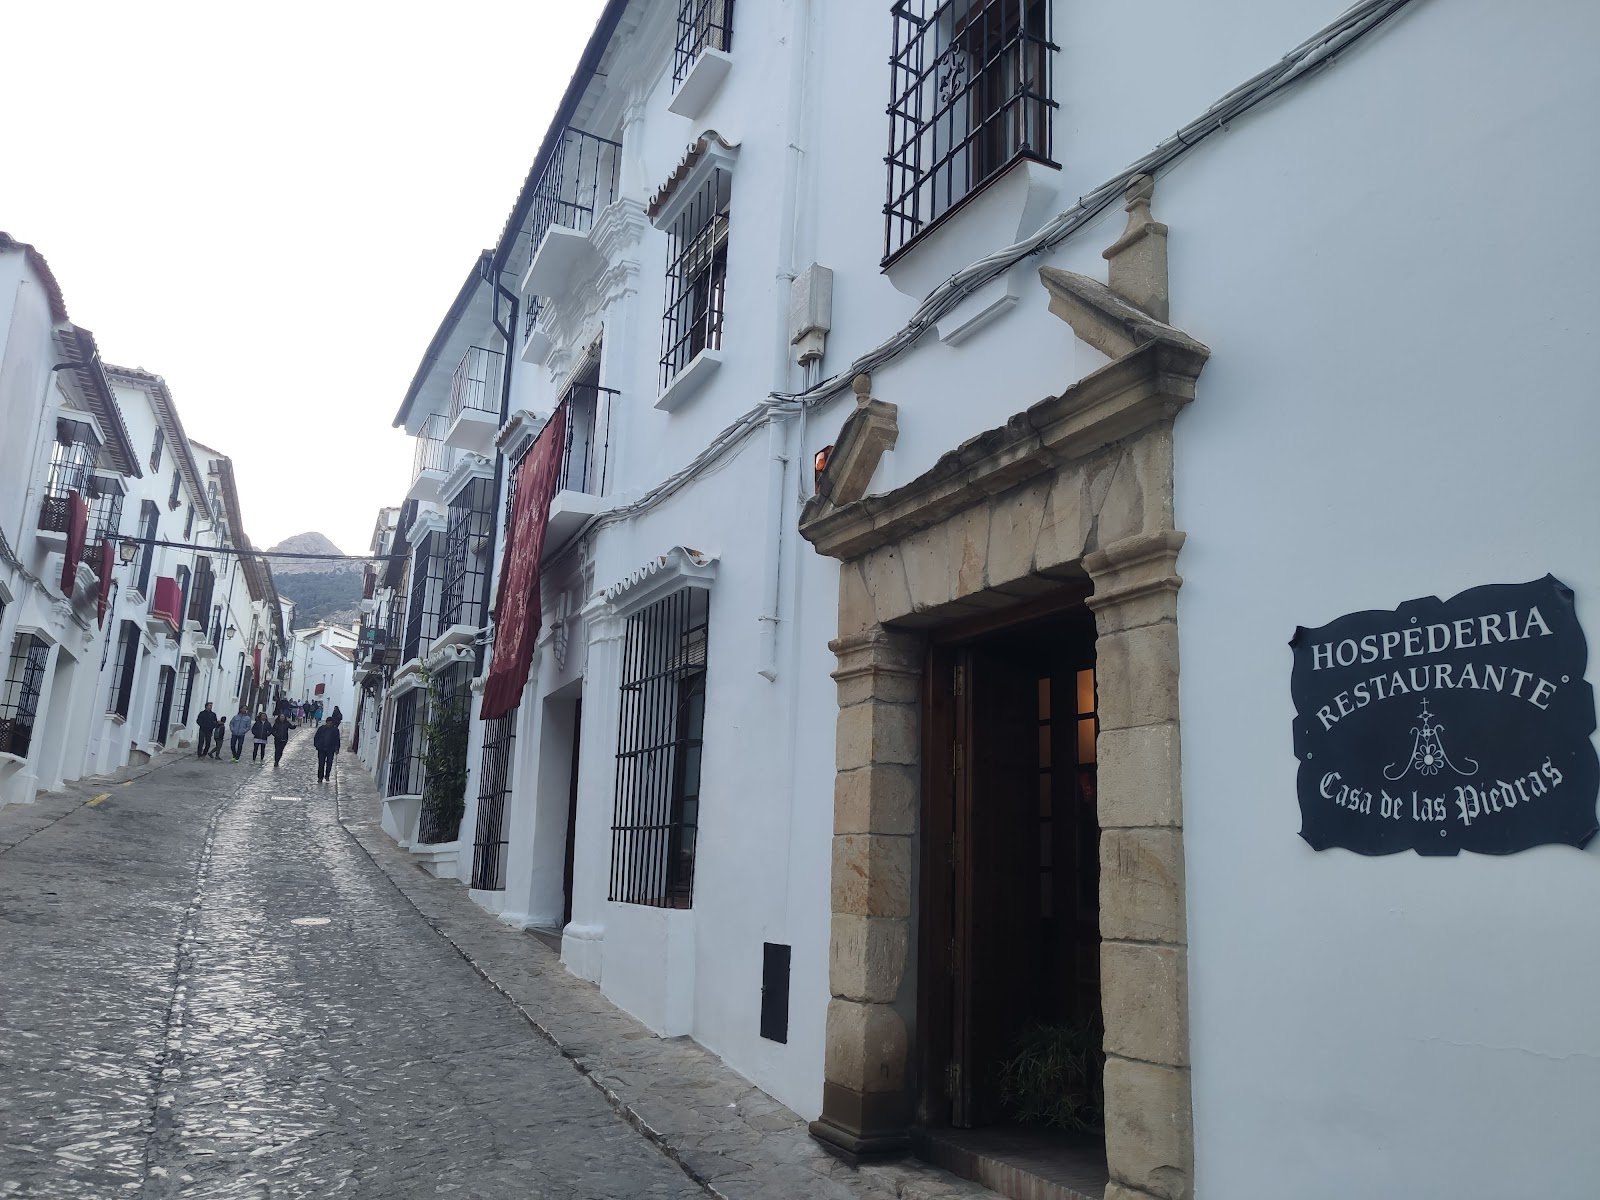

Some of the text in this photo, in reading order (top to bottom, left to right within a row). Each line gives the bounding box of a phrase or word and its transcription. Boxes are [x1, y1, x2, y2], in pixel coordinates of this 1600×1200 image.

[1311, 606, 1553, 670] HOSPEDERIA
[1316, 663, 1557, 731] RESTAURANTE
[1319, 756, 1563, 826] Casa de las Piedras
